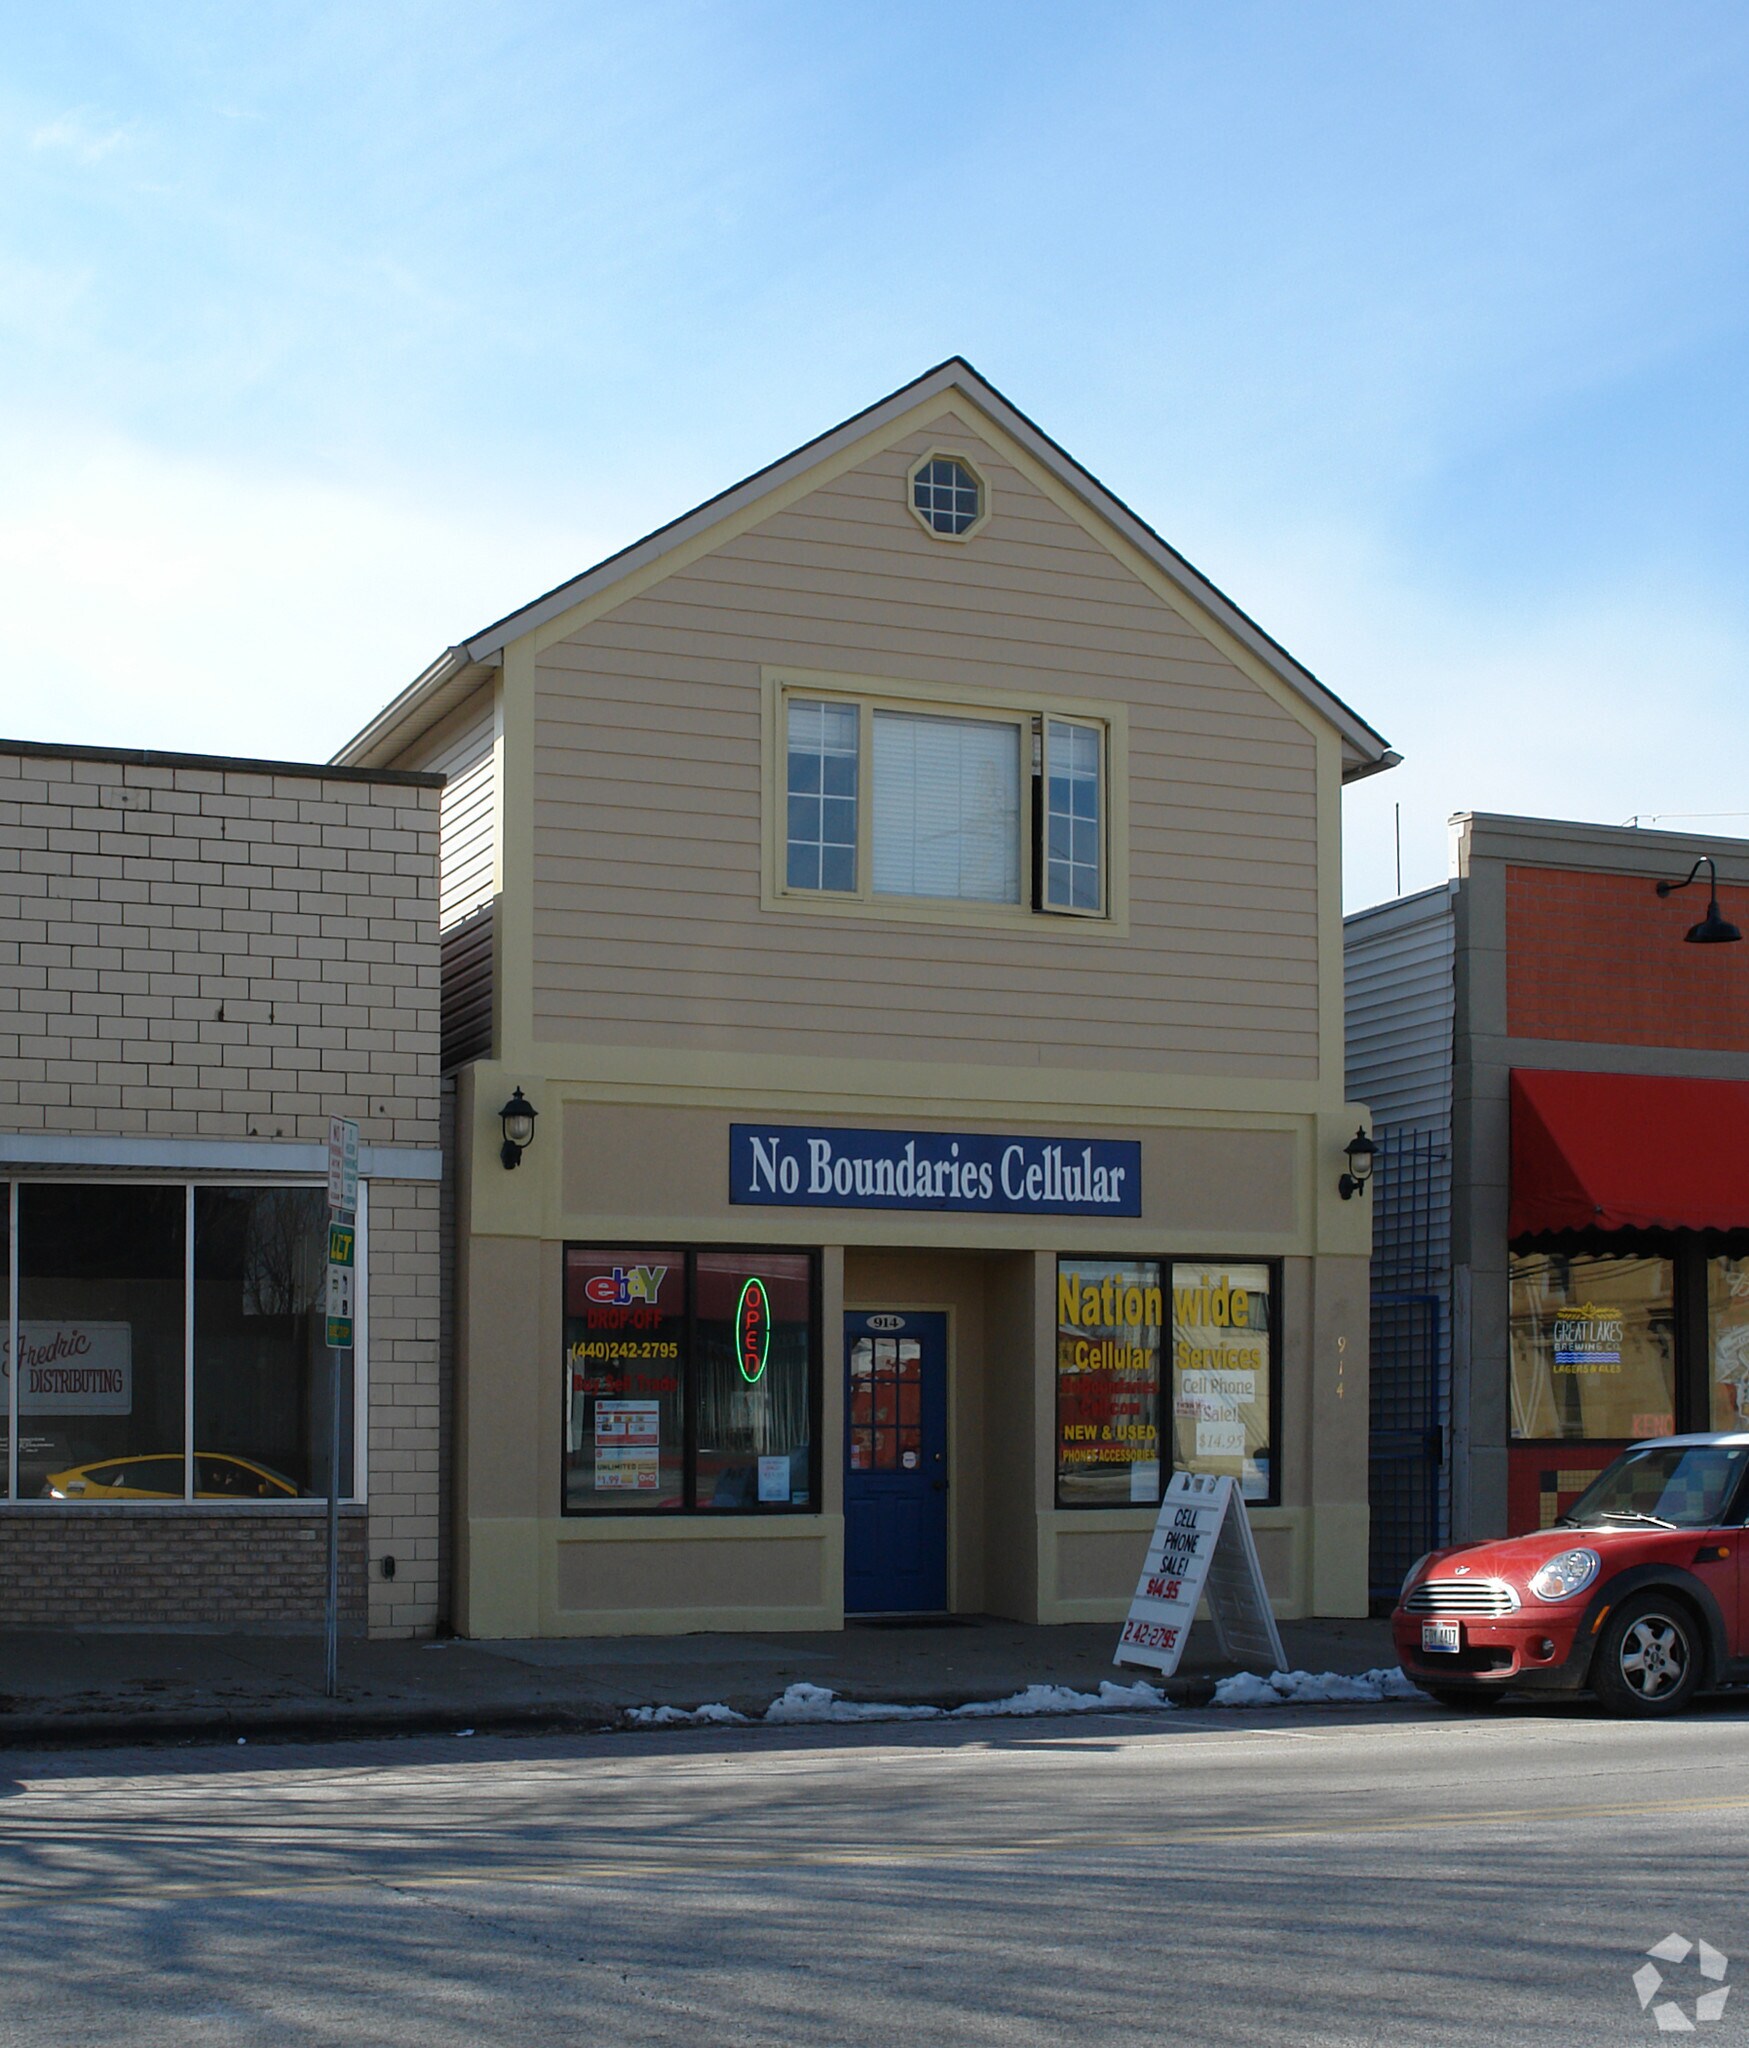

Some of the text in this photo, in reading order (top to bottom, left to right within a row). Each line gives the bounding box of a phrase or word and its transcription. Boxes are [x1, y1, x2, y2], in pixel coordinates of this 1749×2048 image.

[749, 1136, 1126, 1203] No Boundaries Cellular
[330, 1232, 353, 1261] LCT
[587, 1308, 663, 1330] DROP-OFF
[873, 1317, 898, 1328] 914
[1554, 1320, 1623, 1342] GREAT LAKES
[571, 1341, 679, 1362] (440)242-2795
[1075, 1341, 1261, 1370] Cellular Services
[1554, 1342, 1602, 1352] BREWING
[29, 1368, 123, 1393] DISTRIBUTING
[573, 1373, 679, 1396] Buy Sell Trade
[1183, 1377, 1253, 1394] Cell Phone
[1203, 1406, 1236, 1422] Sale!
[1064, 1424, 1156, 1440] NEW & USED
[1633, 1414, 1675, 1437] KENO
[1199, 1434, 1244, 1449] $14.95
[1099, 1449, 1156, 1463] ACCESSORIES
[597, 1463, 637, 1471] UNLIMITED
[1174, 1508, 1199, 1529] CELL
[1164, 1531, 1200, 1554] PHONE
[1159, 1555, 1190, 1577] SALE!
